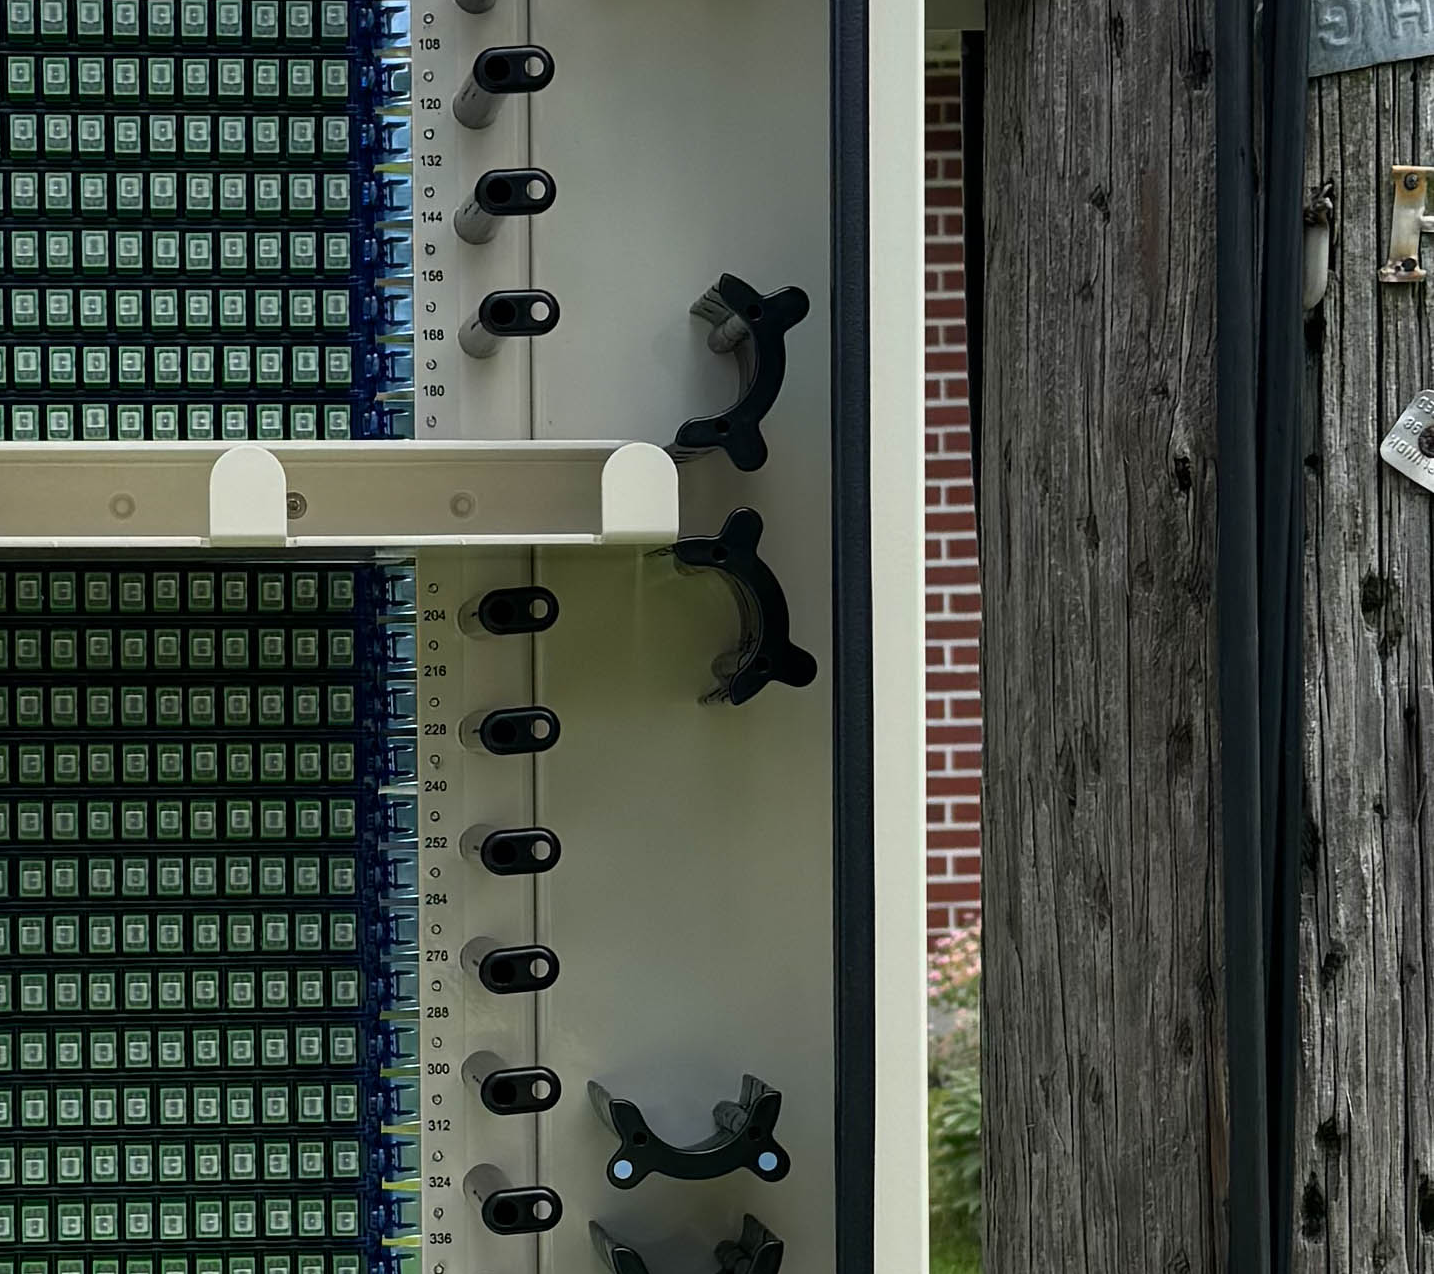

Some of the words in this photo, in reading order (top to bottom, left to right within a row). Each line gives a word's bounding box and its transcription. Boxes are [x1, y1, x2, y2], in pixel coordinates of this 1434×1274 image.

[419, 38, 441, 51] 108
[420, 98, 442, 110] 120
[420, 154, 442, 167] 132
[421, 211, 443, 223] 144
[423, 384, 445, 397] 180
[423, 609, 446, 622] 204
[424, 664, 447, 677] 216
[424, 723, 447, 736] 228
[424, 780, 448, 792] 240
[424, 836, 448, 849] 252
[426, 1006, 450, 1019] 288
[427, 1062, 450, 1075] 300
[428, 1119, 451, 1132] 312
[429, 1176, 451, 1188] 324
[429, 1232, 453, 1245] 336
